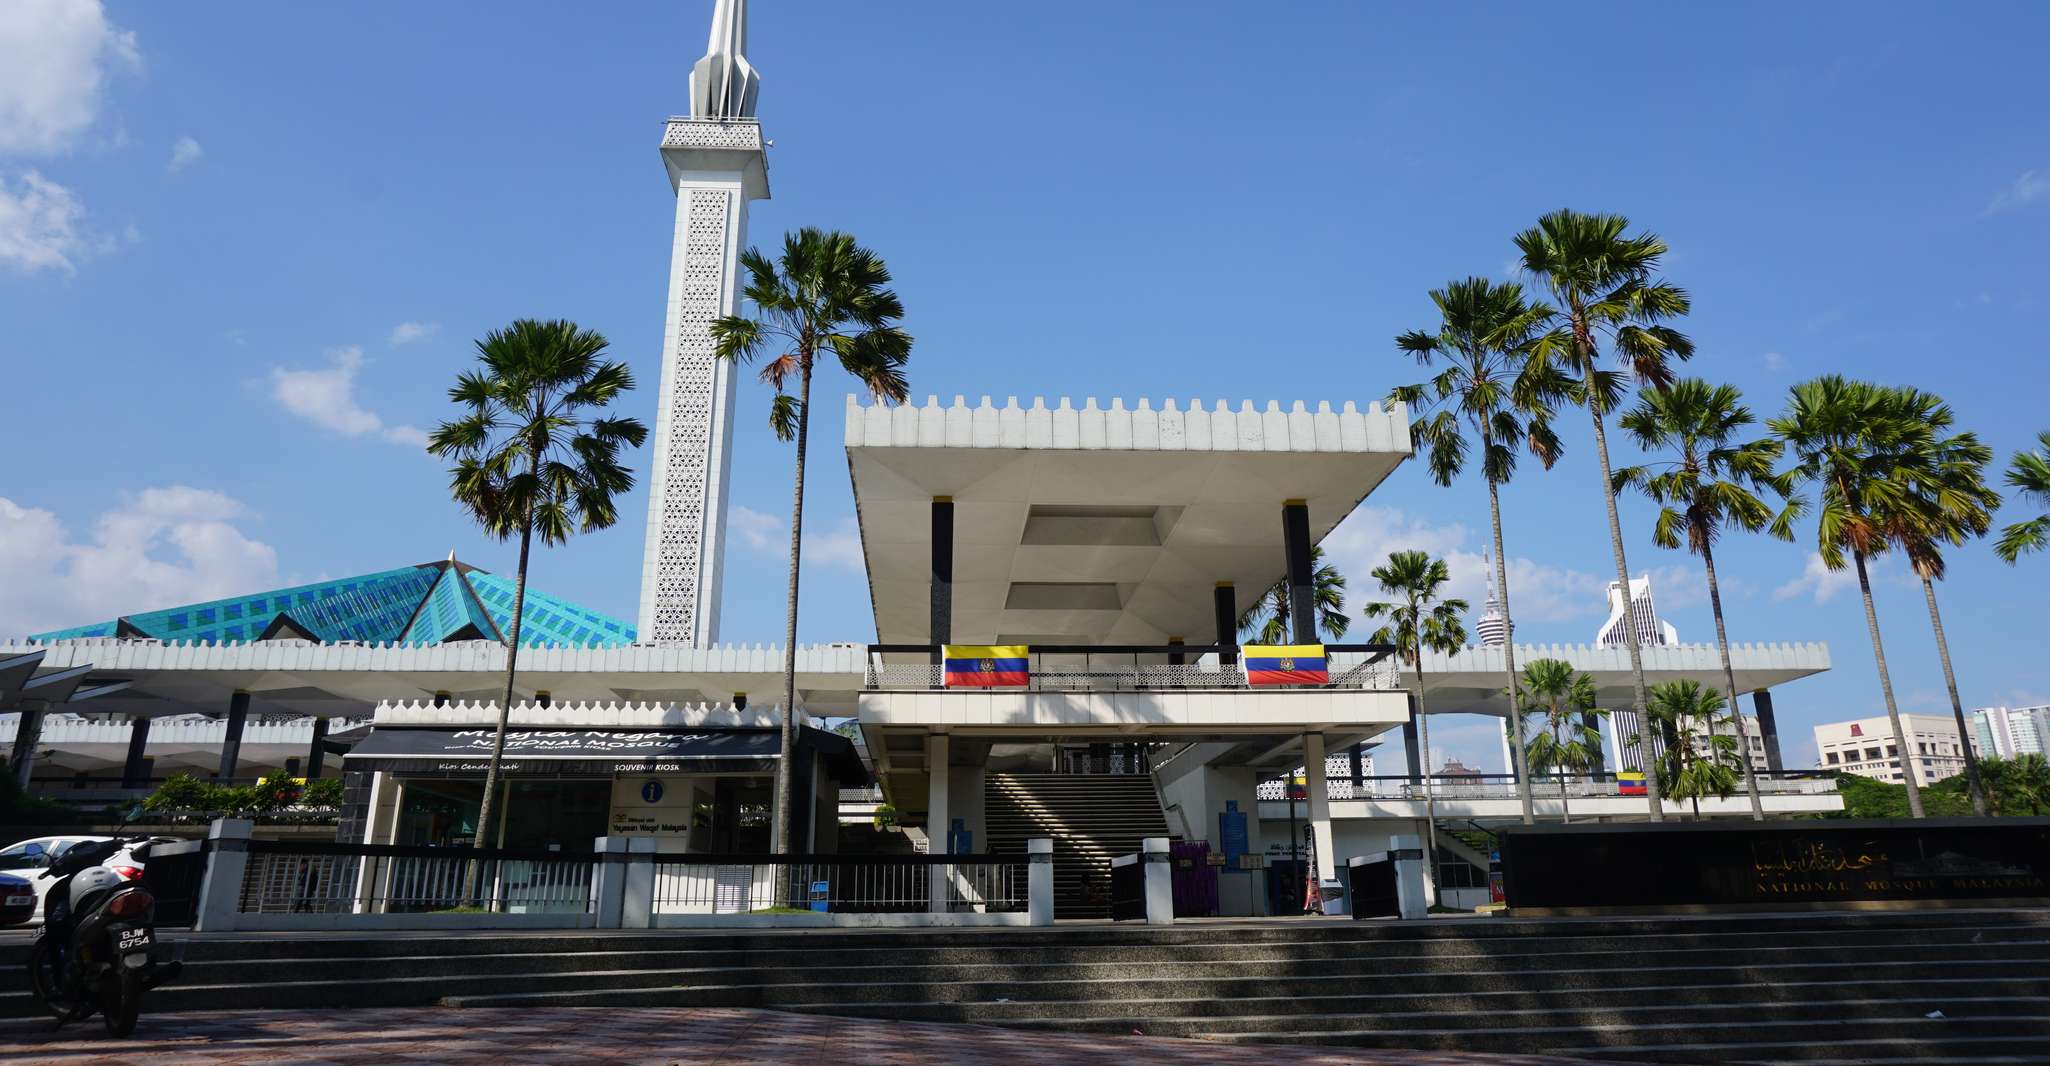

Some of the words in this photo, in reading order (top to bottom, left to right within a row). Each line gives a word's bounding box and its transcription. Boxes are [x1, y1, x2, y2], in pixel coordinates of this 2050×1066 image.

[584, 731, 710, 743] Negara
[587, 739, 680, 749] MOSQUE
[662, 825, 687, 833] Malaysia
[1755, 880, 1849, 894] NATIONAL
[1864, 878, 1938, 892] MOSQUE
[1952, 876, 2047, 890] MALAYSIA
[122, 927, 144, 940] BJW
[119, 936, 150, 949] 6754
